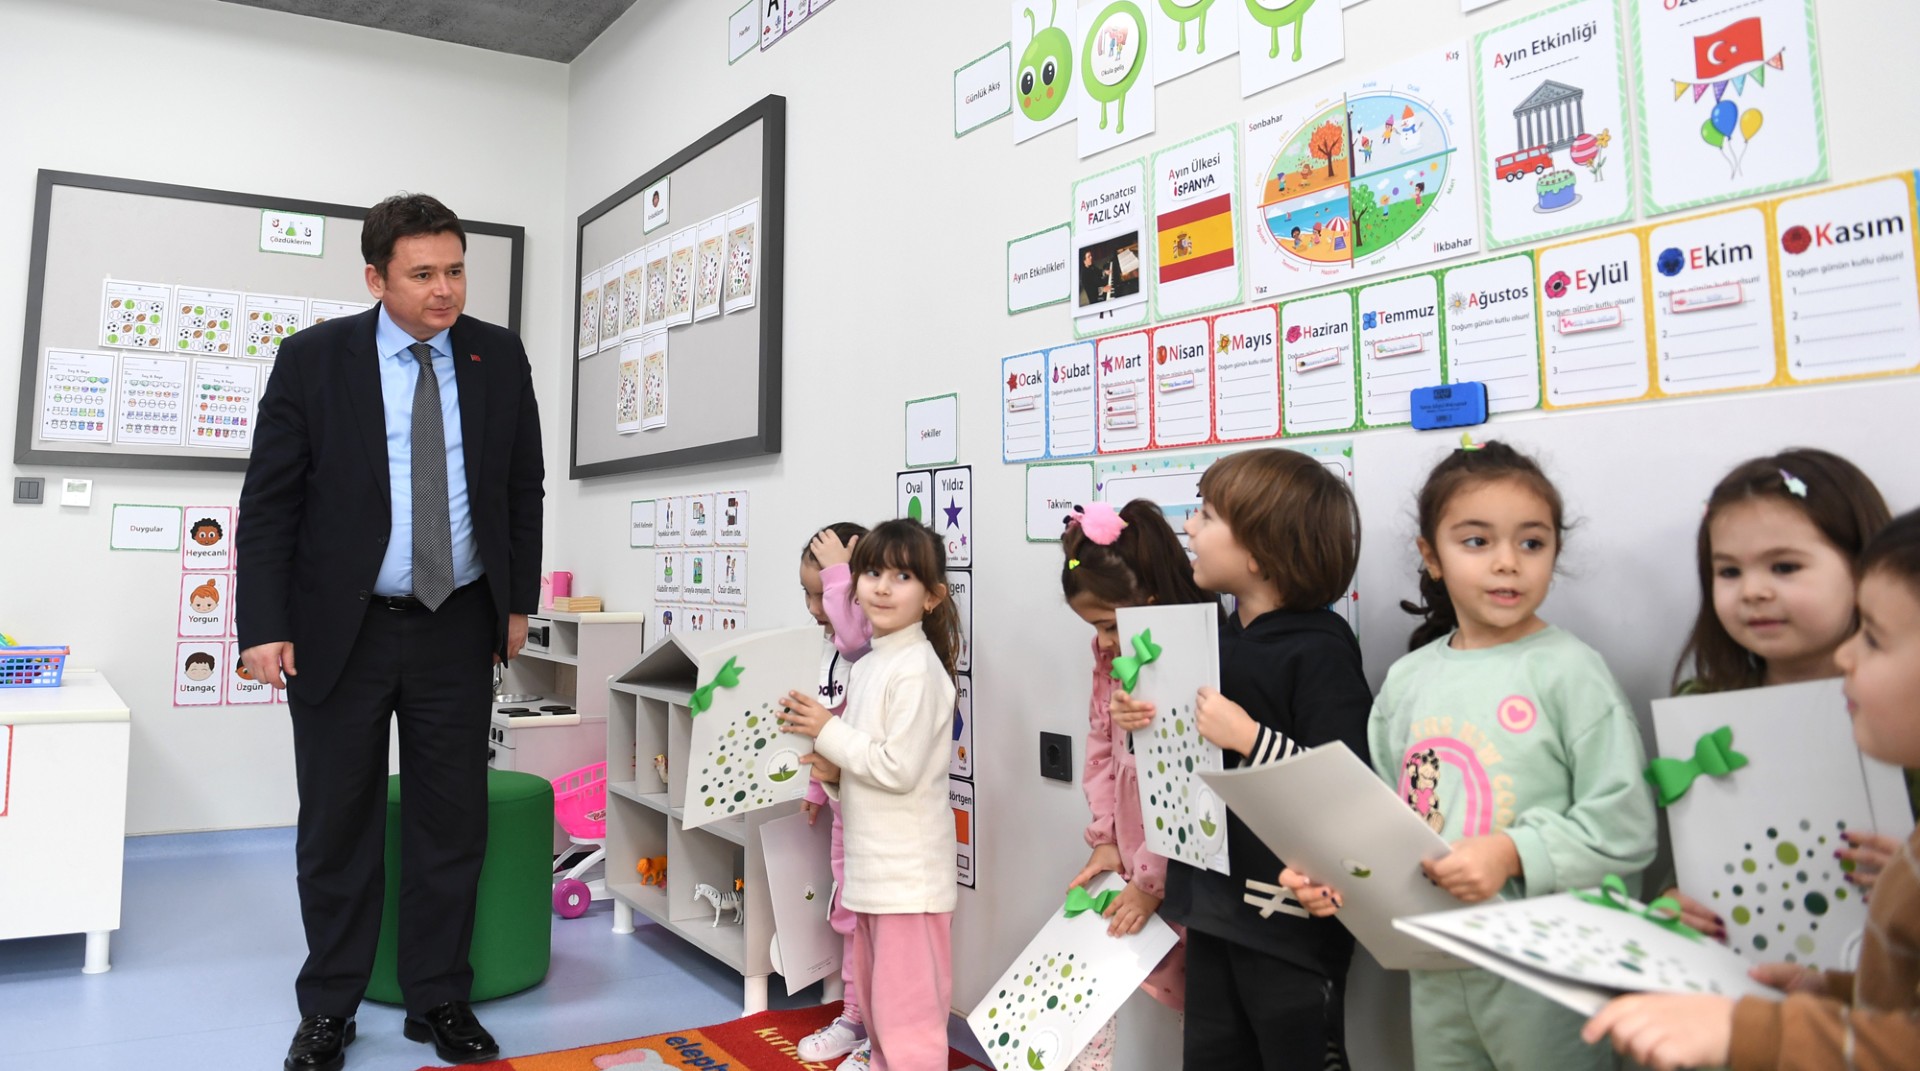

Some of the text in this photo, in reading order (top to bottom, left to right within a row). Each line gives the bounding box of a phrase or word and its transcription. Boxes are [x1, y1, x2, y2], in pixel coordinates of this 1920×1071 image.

[1494, 20, 1597, 68] Ayın Etkinliği
[966, 81, 1000, 104] Günlük Akış
[1248, 114, 1283, 132] Sonbahar
[1168, 152, 1220, 180] Ayın Ülkesi
[1081, 198, 1098, 211] Ayın
[1088, 200, 1130, 225] FAZIL SAY
[1816, 214, 1904, 247] Kasım
[270, 236, 311, 246] Çözdüklerim
[1690, 242, 1753, 270] Ekim
[1013, 259, 1066, 284] Ayın Etkinlikleri
[1787, 252, 1904, 278] Doğum günün kutlu olsun!
[1575, 260, 1629, 293] Eylül
[1469, 286, 1529, 309] Ağustos
[1615, 297, 1635, 306] olsun!
[1378, 304, 1435, 325] Temmuz
[1475, 319, 1493, 328] günün
[1512, 312, 1529, 322] olsun!
[1304, 321, 1348, 339] Haziran
[1232, 332, 1272, 352] Mayıs
[1170, 344, 1204, 361] Nisan
[1114, 354, 1141, 371] Mart
[1019, 370, 1042, 386] Ocak
[1060, 363, 1090, 383] Şubat
[920, 429, 941, 441] Şekiller
[906, 481, 923, 494] Oval
[942, 478, 964, 491] Yıldız
[1046, 499, 1072, 510] Takvim
[130, 525, 163, 533] Duygular
[189, 615, 218, 624] Yorgun
[180, 684, 215, 693] Utangaç
[237, 682, 263, 692] Üzgün
